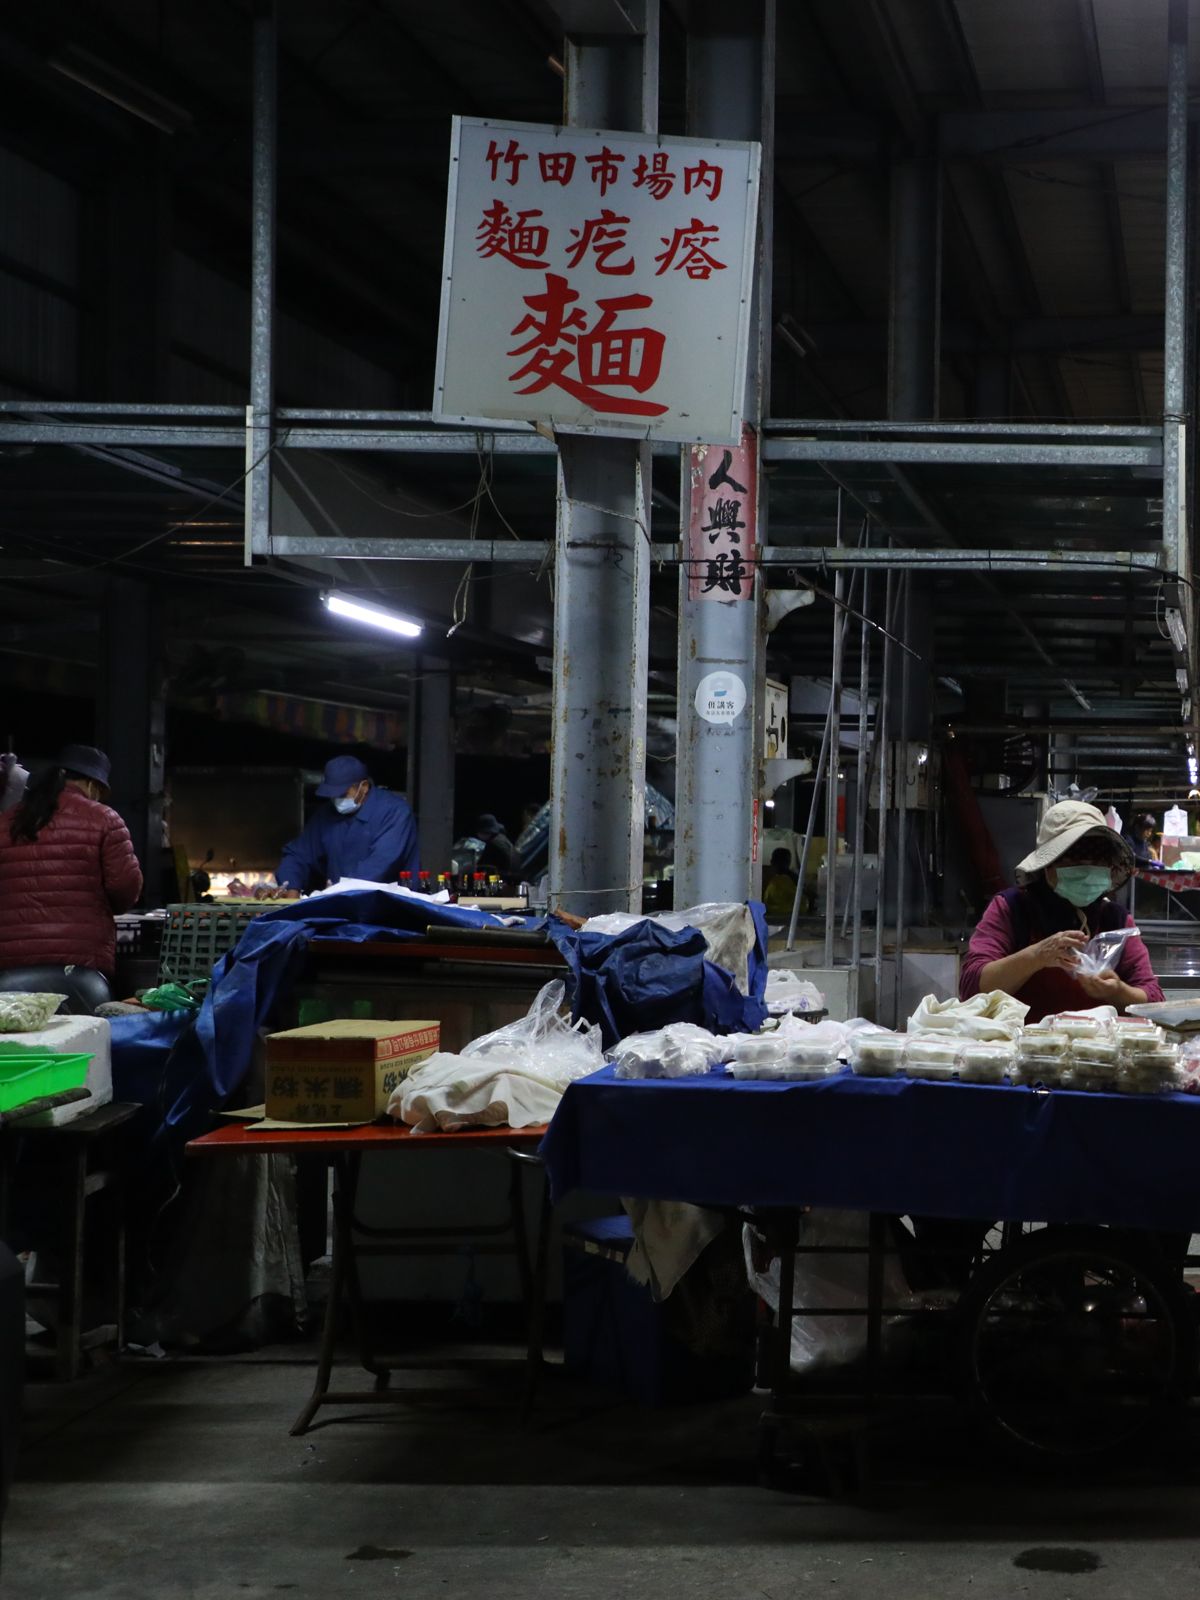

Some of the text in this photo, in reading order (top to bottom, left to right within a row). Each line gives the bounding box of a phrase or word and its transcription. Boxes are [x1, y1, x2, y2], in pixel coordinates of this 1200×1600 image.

[475, 199, 727, 280] 麵疙瘩
[507, 273, 669, 417] 麵
